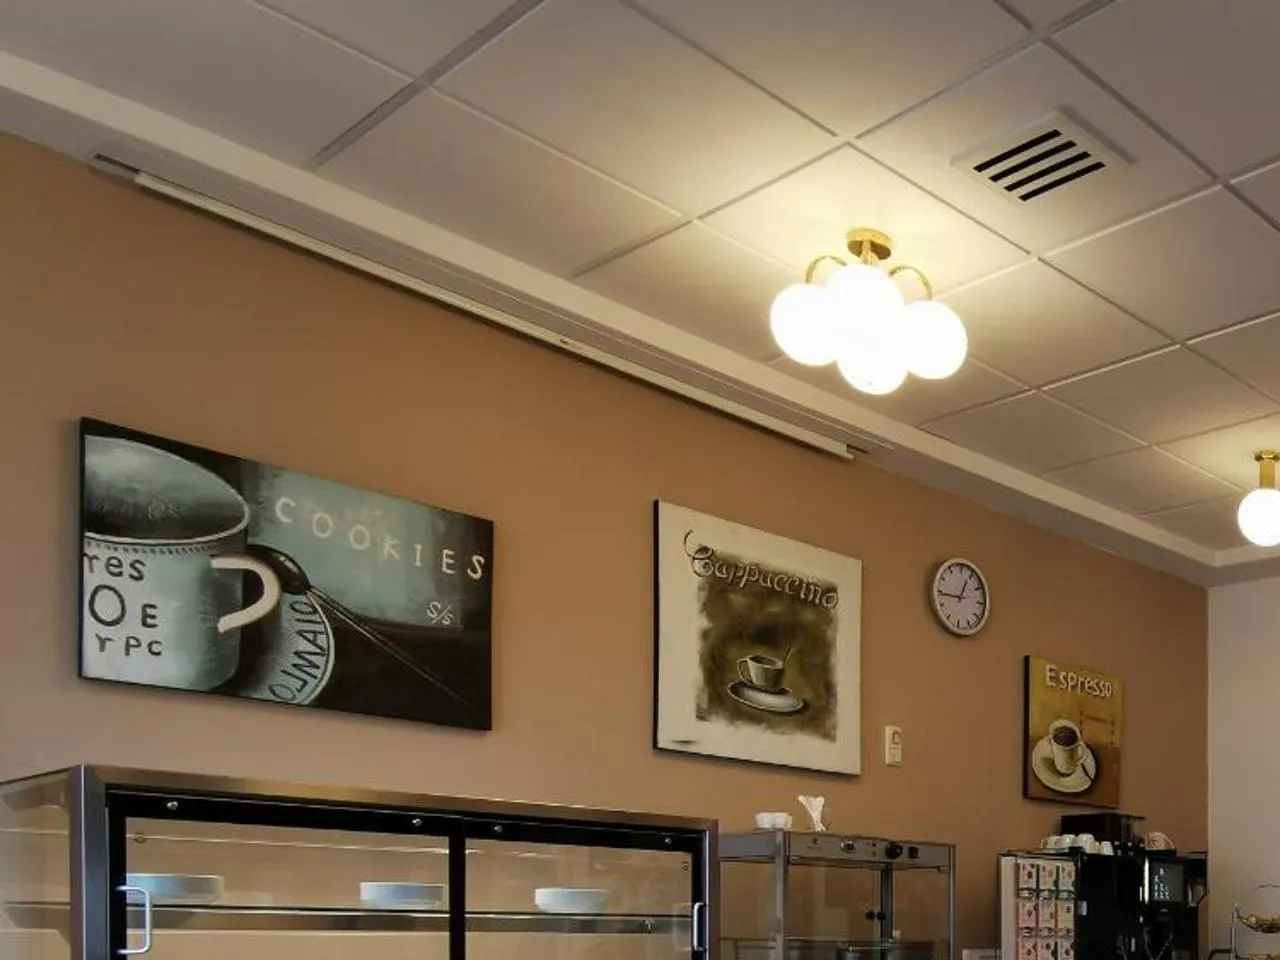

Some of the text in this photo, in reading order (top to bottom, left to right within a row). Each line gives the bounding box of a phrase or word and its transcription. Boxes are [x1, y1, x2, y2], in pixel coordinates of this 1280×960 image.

[274, 496, 486, 580] COOKIES
[683, 530, 839, 609] Cappuccino
[1045, 665, 1112, 698] Espresso
